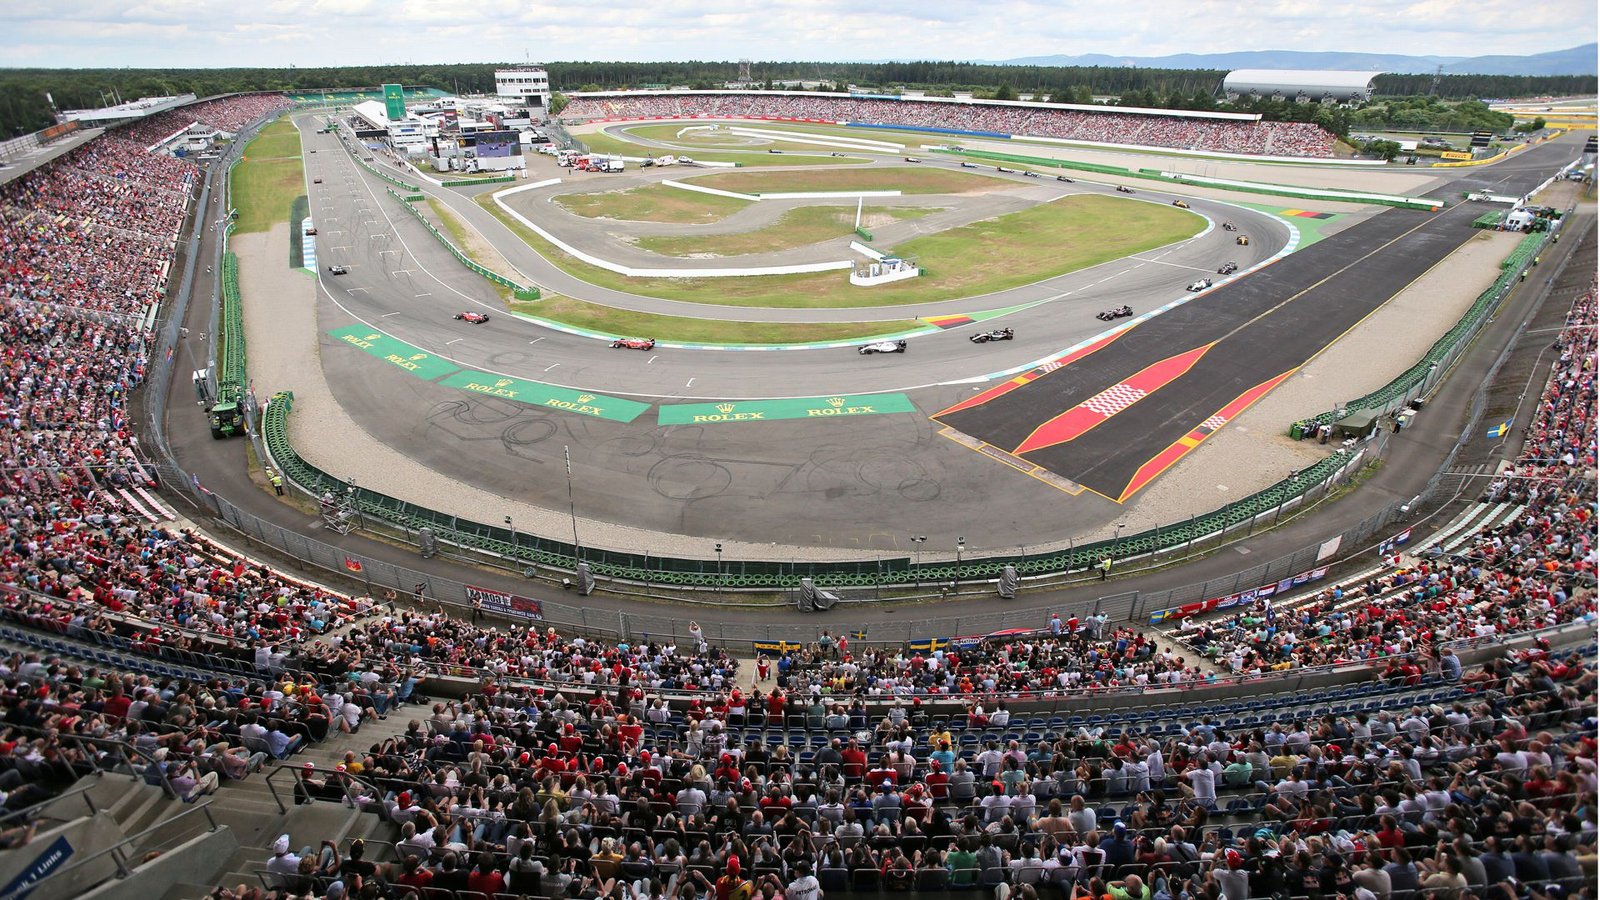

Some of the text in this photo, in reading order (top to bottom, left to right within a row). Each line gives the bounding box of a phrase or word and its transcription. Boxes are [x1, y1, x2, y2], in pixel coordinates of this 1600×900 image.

[341, 334, 374, 349] ROLEX
[384, 354, 421, 371] ROLEX
[463, 382, 519, 398] ROLEX
[544, 398, 605, 416] ROLEX
[806, 406, 877, 416] ROLEX
[693, 411, 765, 423] ROLEX
[37, 850, 62, 874] Links
